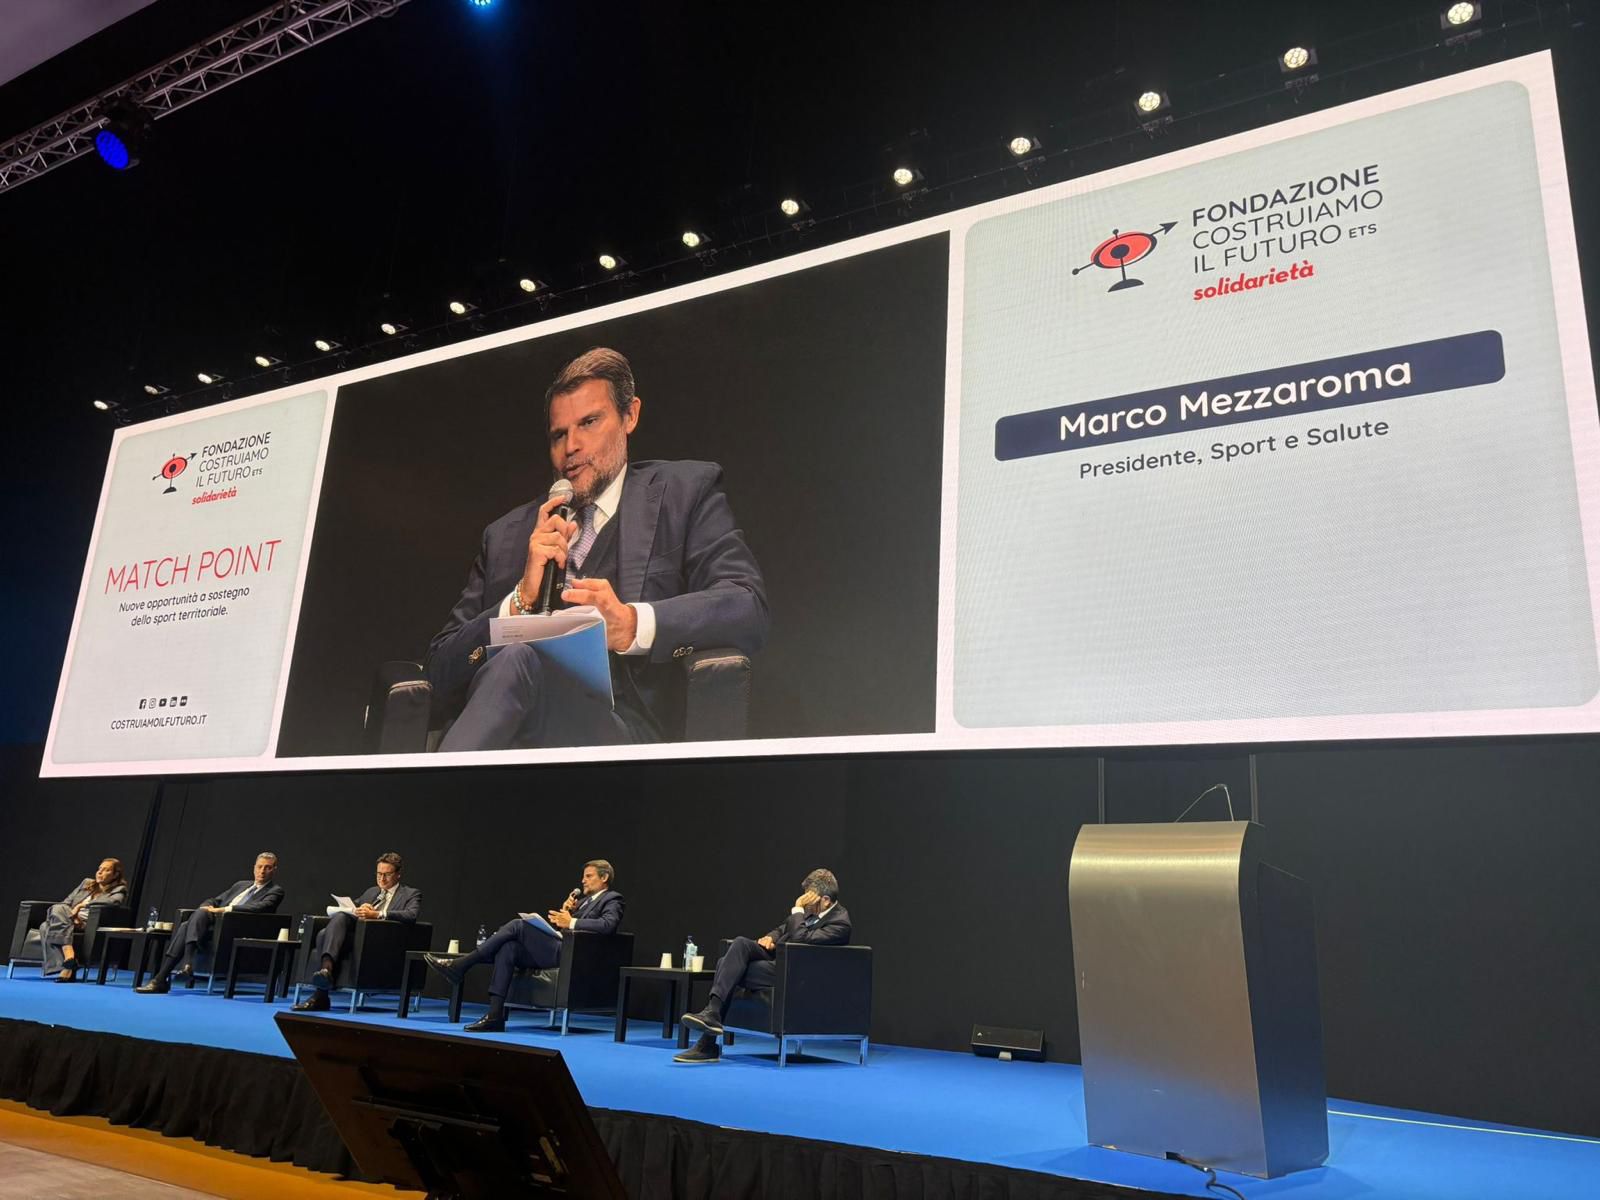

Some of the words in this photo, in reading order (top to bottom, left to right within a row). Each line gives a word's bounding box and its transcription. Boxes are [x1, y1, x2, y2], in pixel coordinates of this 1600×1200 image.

[1193, 164, 1379, 227] FONDAZIONE
[1193, 190, 1383, 249] COSTRUIAMO
[1194, 254, 1215, 273] IL
[1224, 224, 1341, 267] FUTURO
[1349, 223, 1377, 239] ETS
[1194, 260, 1314, 300] solidarietà
[1060, 405, 1167, 440] Marco
[1180, 362, 1411, 421] Mezzaroma
[199, 447, 269, 473] COSTRUIAMO
[202, 432, 271, 458] FONDAZIONE
[1080, 450, 1202, 479] Presidente,
[1211, 436, 1276, 462] Sport
[1285, 435, 1298, 449] e
[1307, 422, 1389, 446] Salute
[196, 476, 204, 487] IL
[207, 466, 251, 485] FUTURO
[252, 468, 263, 476] ETS
[192, 486, 237, 505] solidarietà
[105, 555, 191, 594] MATCH
[197, 540, 282, 581] POINT
[119, 601, 145, 612] Nuove
[147, 592, 198, 610] opportunità
[200, 593, 206, 602] a
[208, 587, 250, 601] sostegno
[131, 615, 151, 626] dello
[153, 612, 176, 625] sport
[179, 605, 228, 620] territoriale.
[111, 714, 207, 730] COSTRUIAMOILFUTURO.IT
